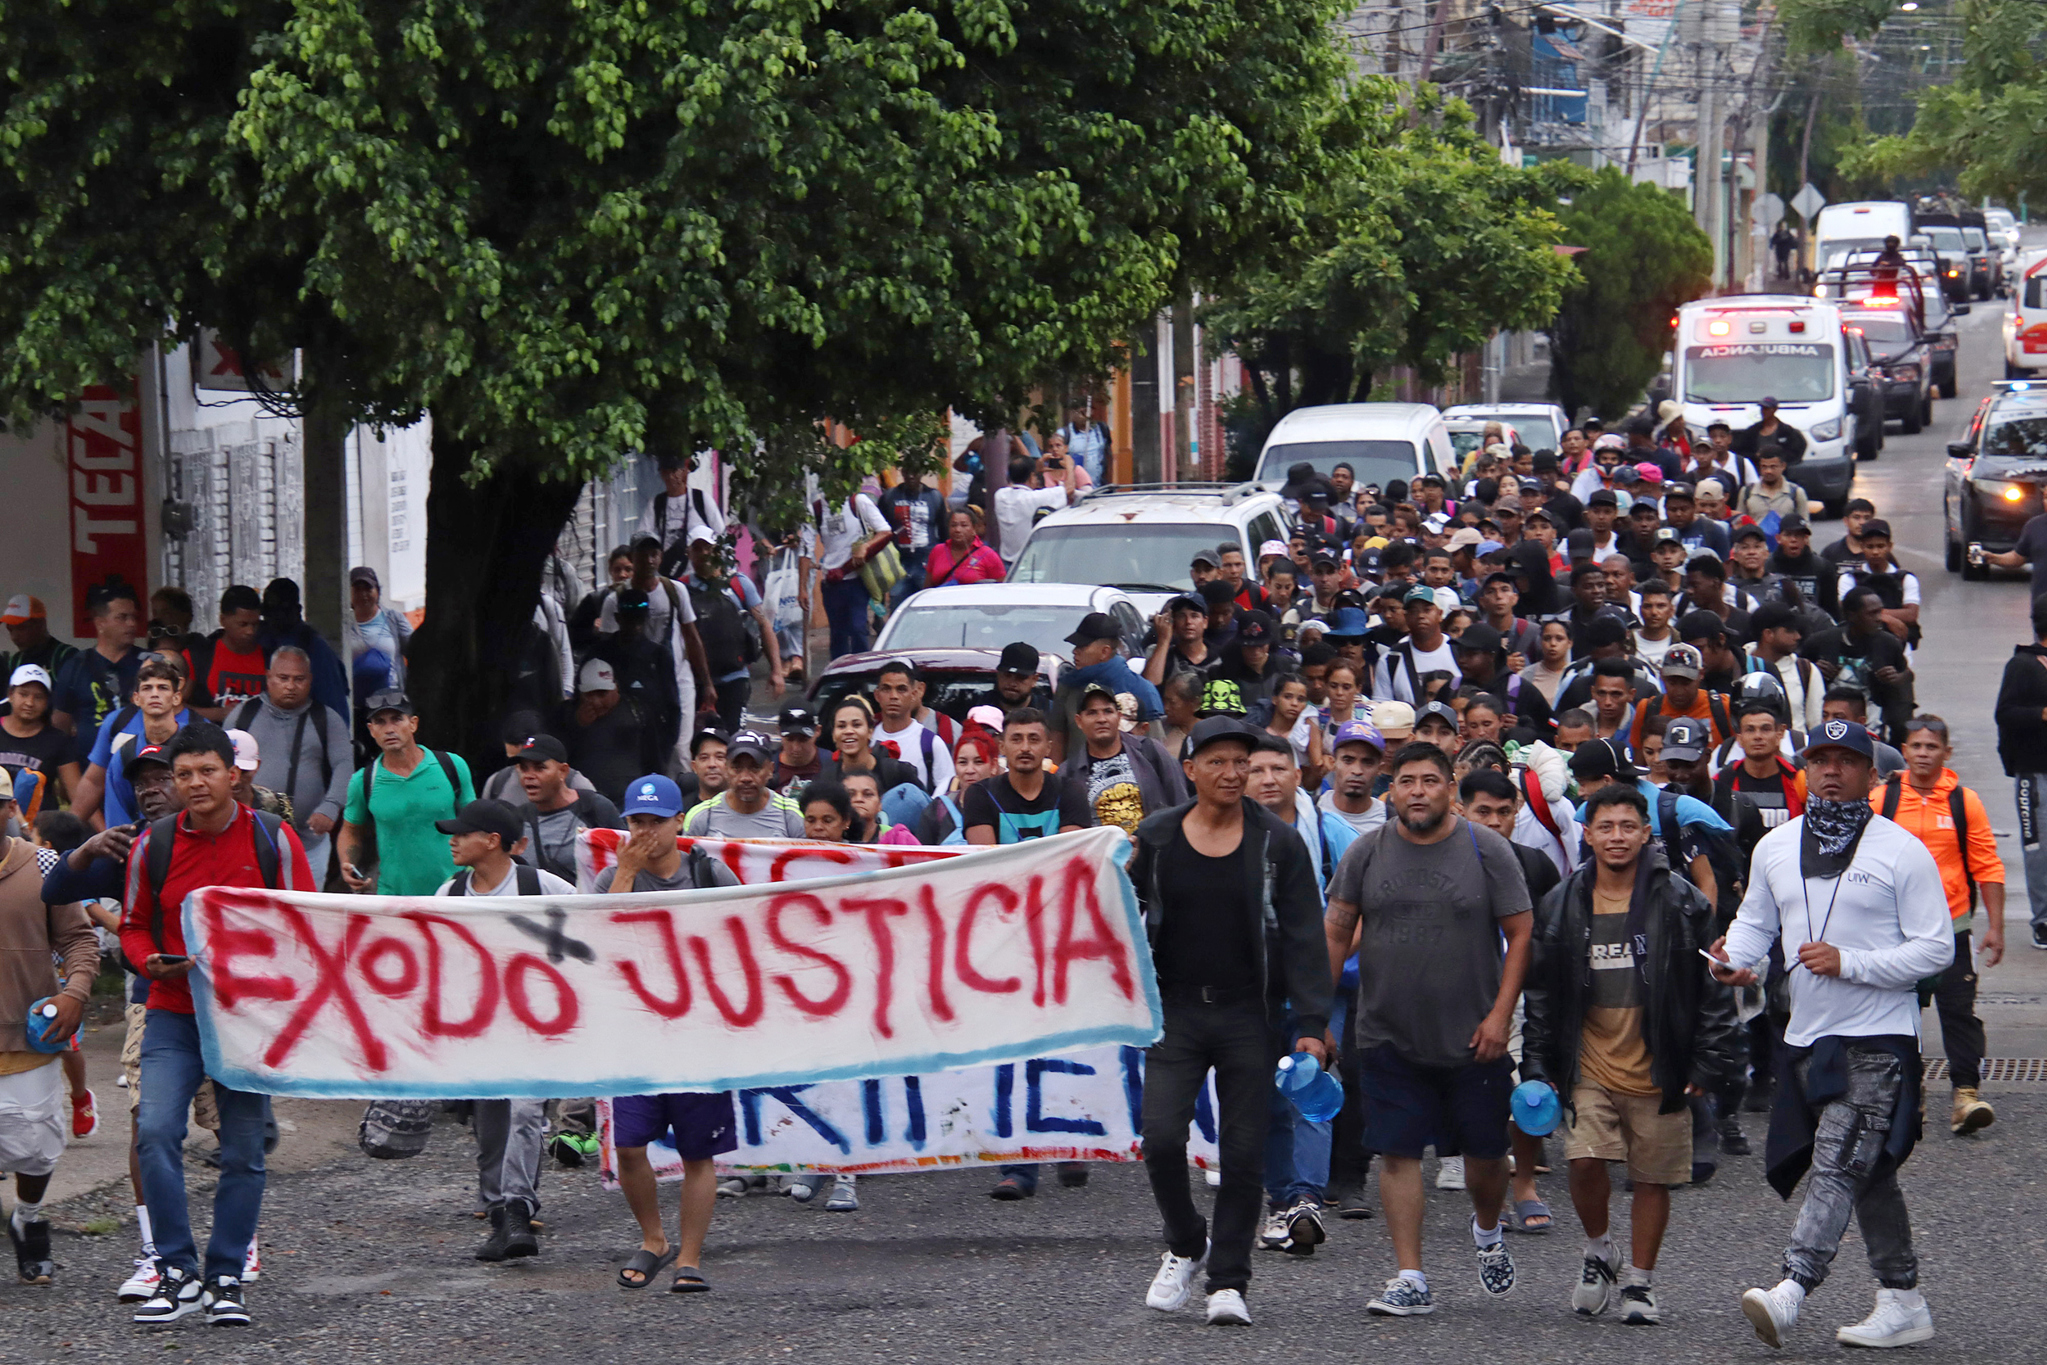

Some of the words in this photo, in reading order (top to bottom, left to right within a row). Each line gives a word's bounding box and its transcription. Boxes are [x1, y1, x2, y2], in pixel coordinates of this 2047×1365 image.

[1847, 872, 1871, 884] UIW
[203, 887, 580, 1072] EXODO
[609, 854, 1135, 1040] JUSTICIA
